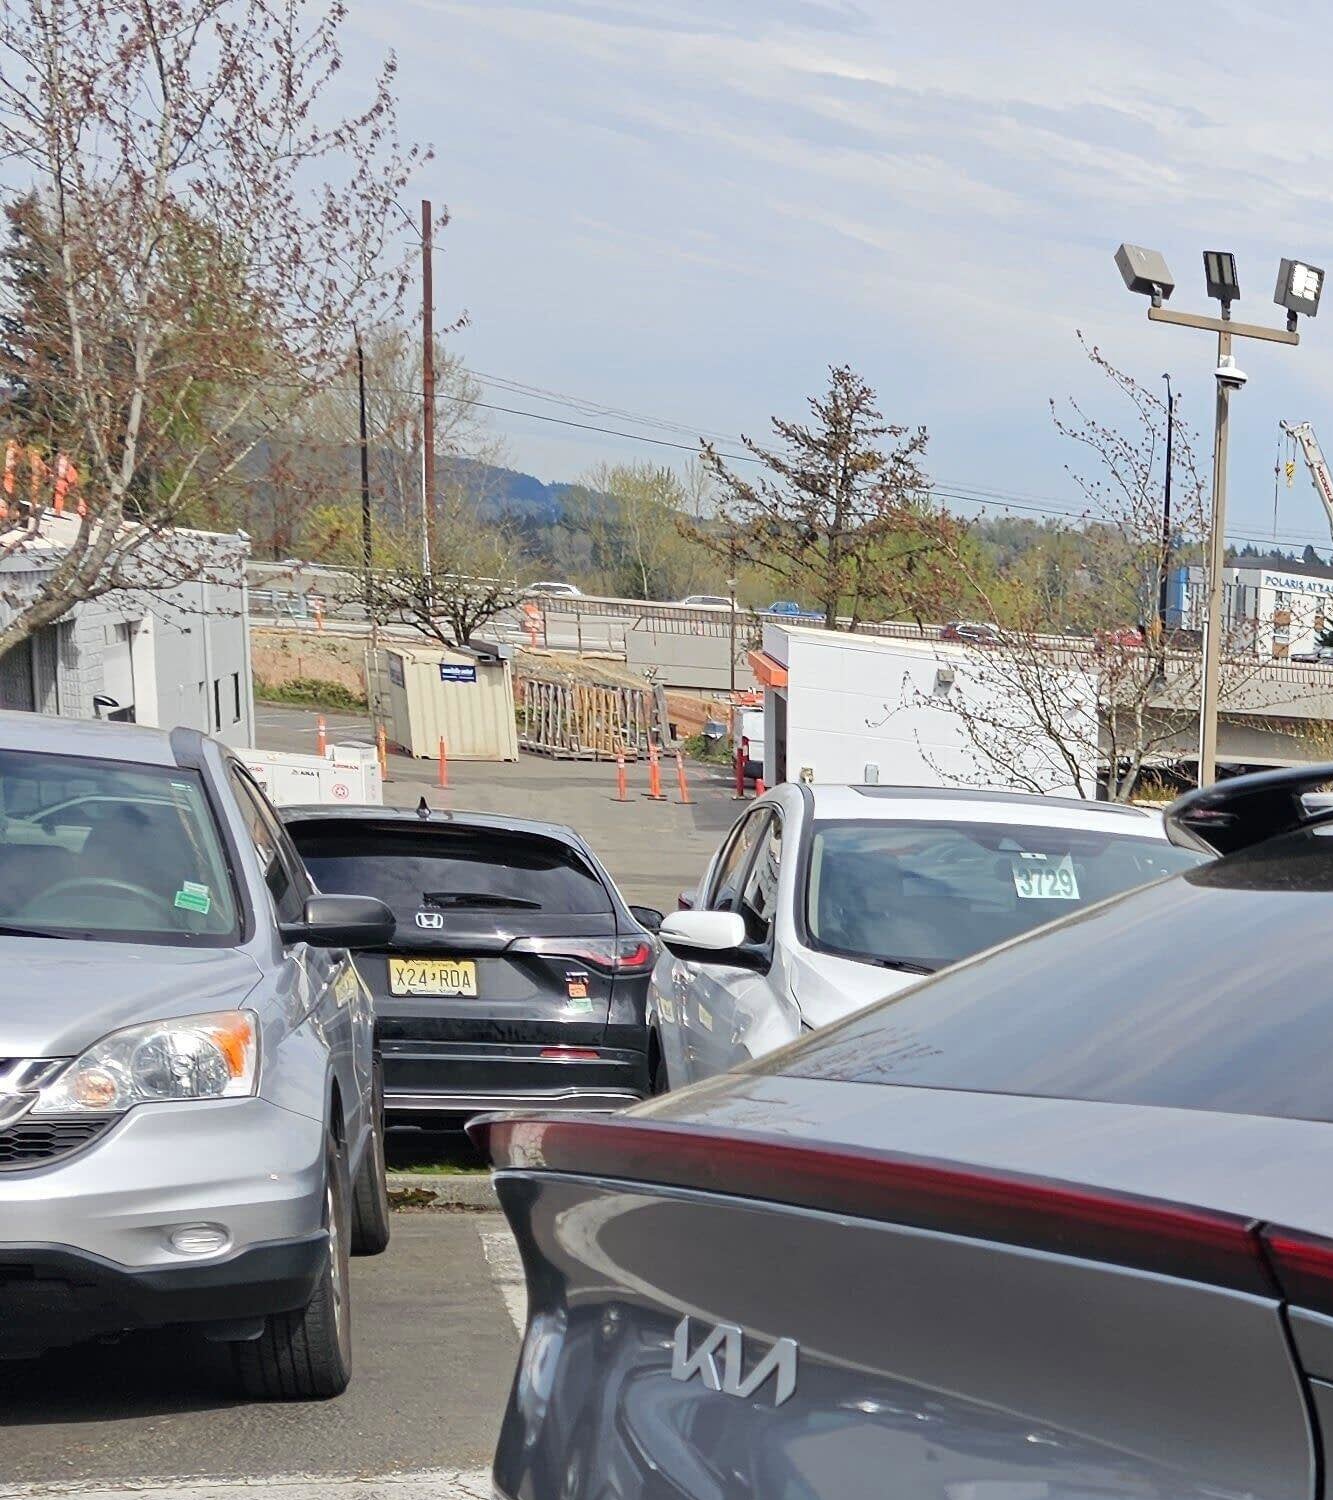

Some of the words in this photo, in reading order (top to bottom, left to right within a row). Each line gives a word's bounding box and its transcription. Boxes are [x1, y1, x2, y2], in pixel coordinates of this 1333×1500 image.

[1265, 575, 1304, 590] POLARIS
[1018, 867, 1074, 896] 3729
[395, 967, 427, 987] X24
[672, 1314, 798, 1408] KIA
